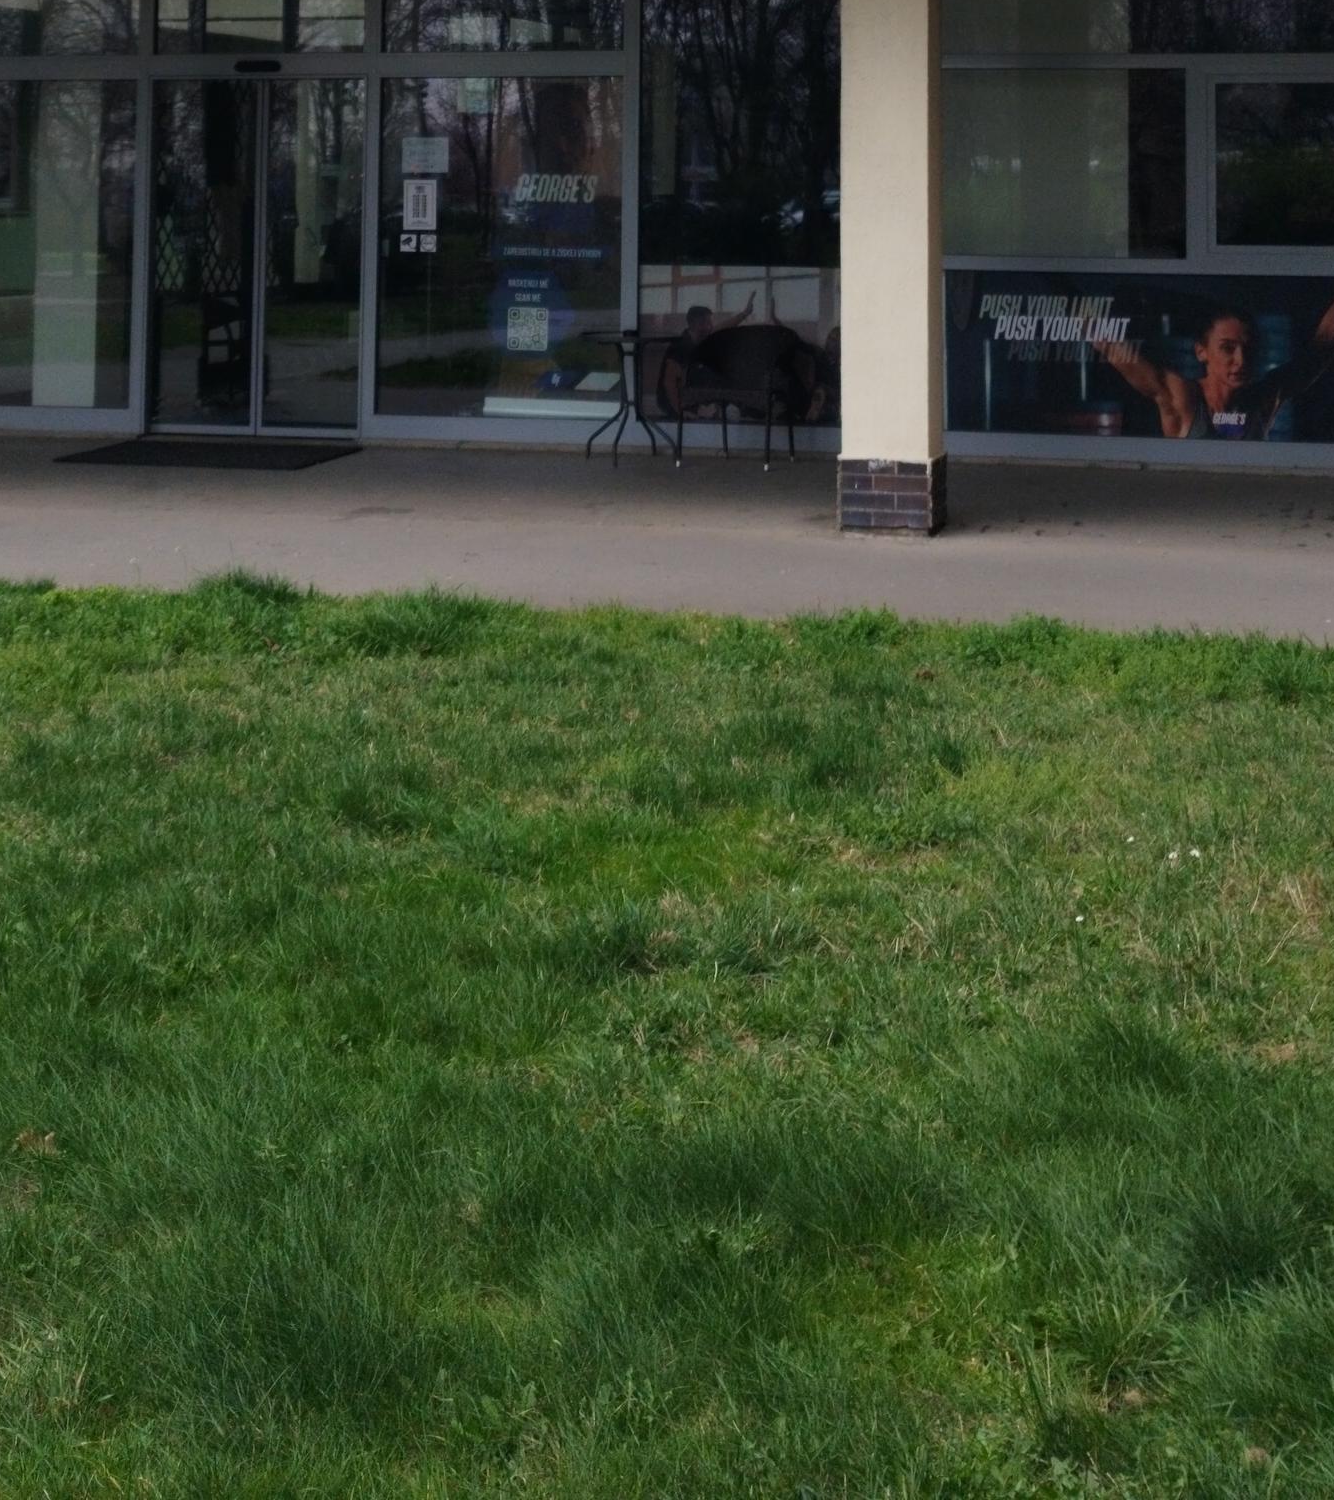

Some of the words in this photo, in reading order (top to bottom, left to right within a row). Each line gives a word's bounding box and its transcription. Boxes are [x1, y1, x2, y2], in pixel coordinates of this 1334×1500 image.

[515, 172, 598, 203] GEORGE'S
[979, 294, 1023, 320] PUSH
[1027, 294, 1068, 319] YOUR
[1070, 296, 1115, 320] LIMIT
[994, 315, 1038, 341] PUSH
[1041, 315, 1085, 342] YOUR
[1085, 317, 1131, 343] LIMIT
[1008, 341, 1051, 362] PUSH
